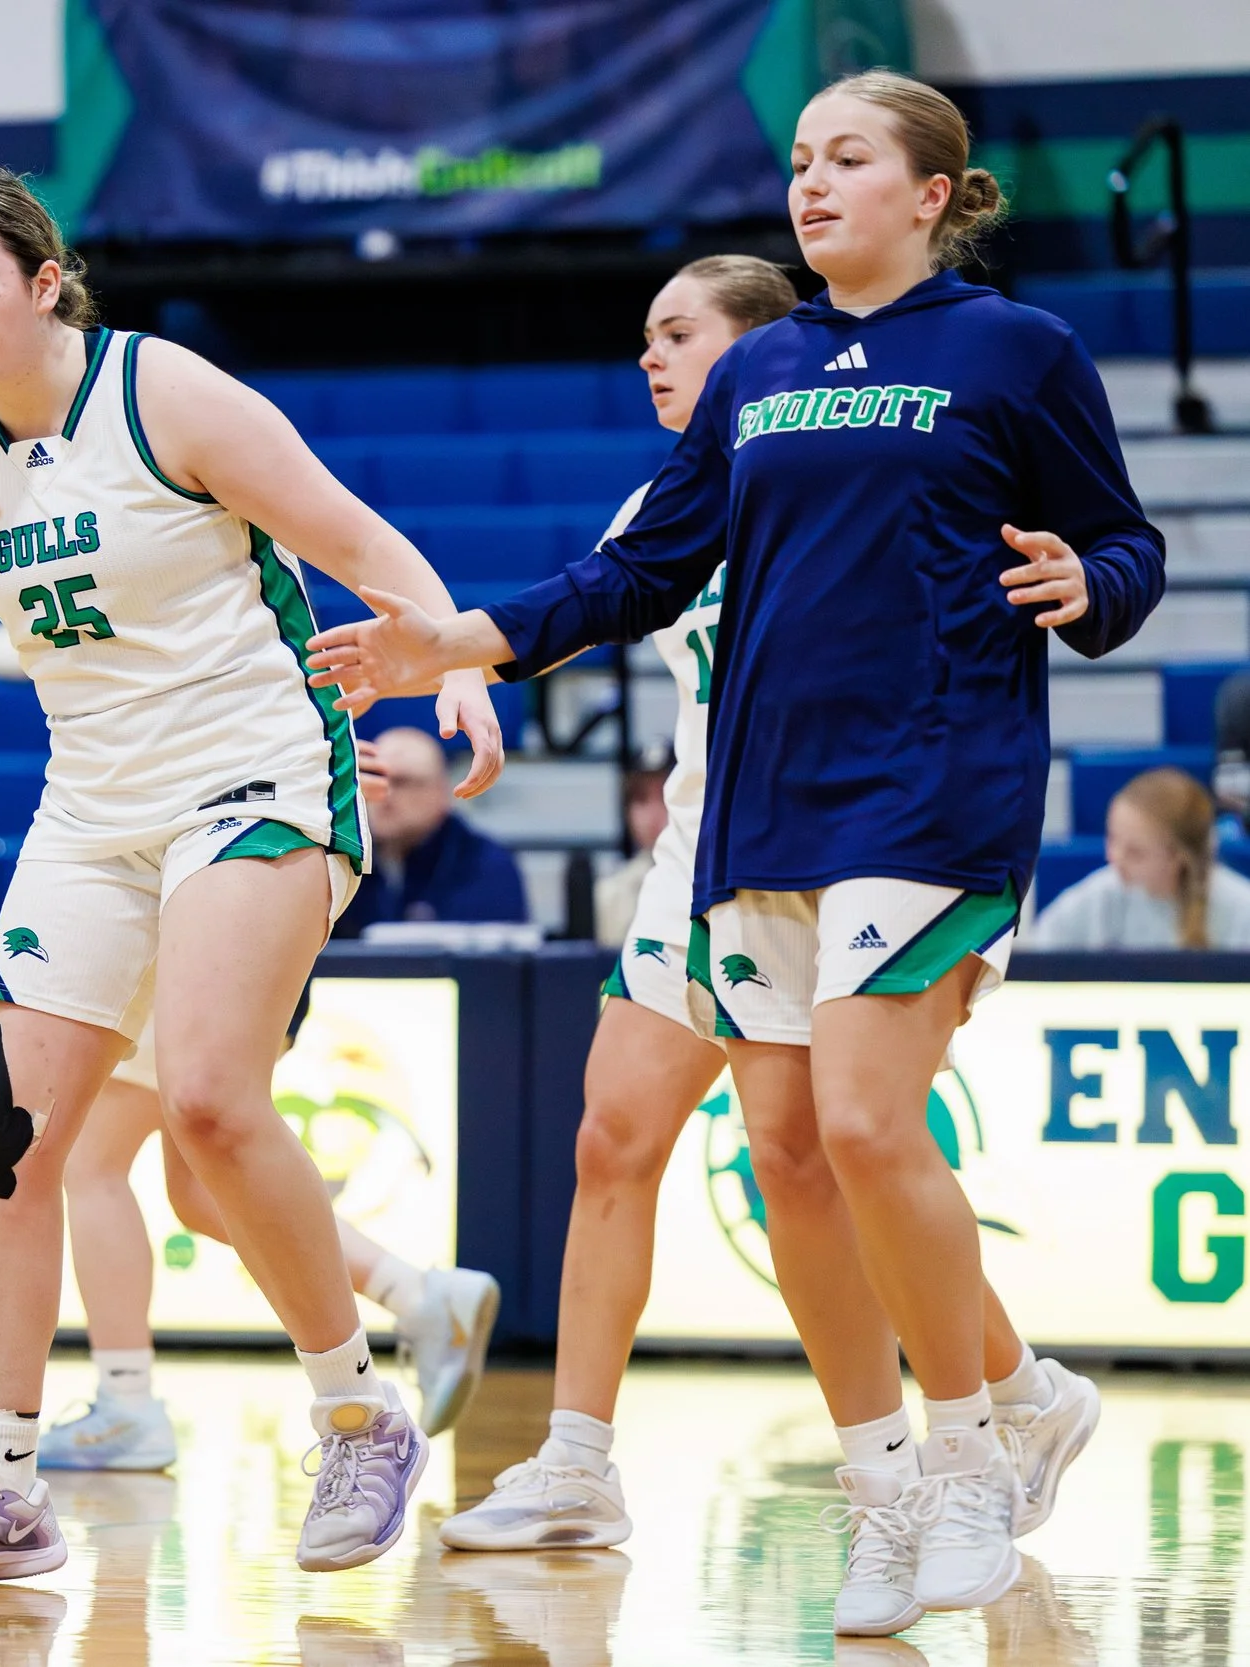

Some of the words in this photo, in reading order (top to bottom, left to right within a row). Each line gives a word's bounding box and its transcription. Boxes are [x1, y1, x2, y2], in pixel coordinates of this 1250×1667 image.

[734, 384, 952, 450] ENDICOTT
[26, 456, 54, 469] adidas
[18, 573, 117, 649] 25
[686, 624, 718, 704] 1
[848, 940, 888, 950] adidas
[1151, 1171, 1245, 1303] G
